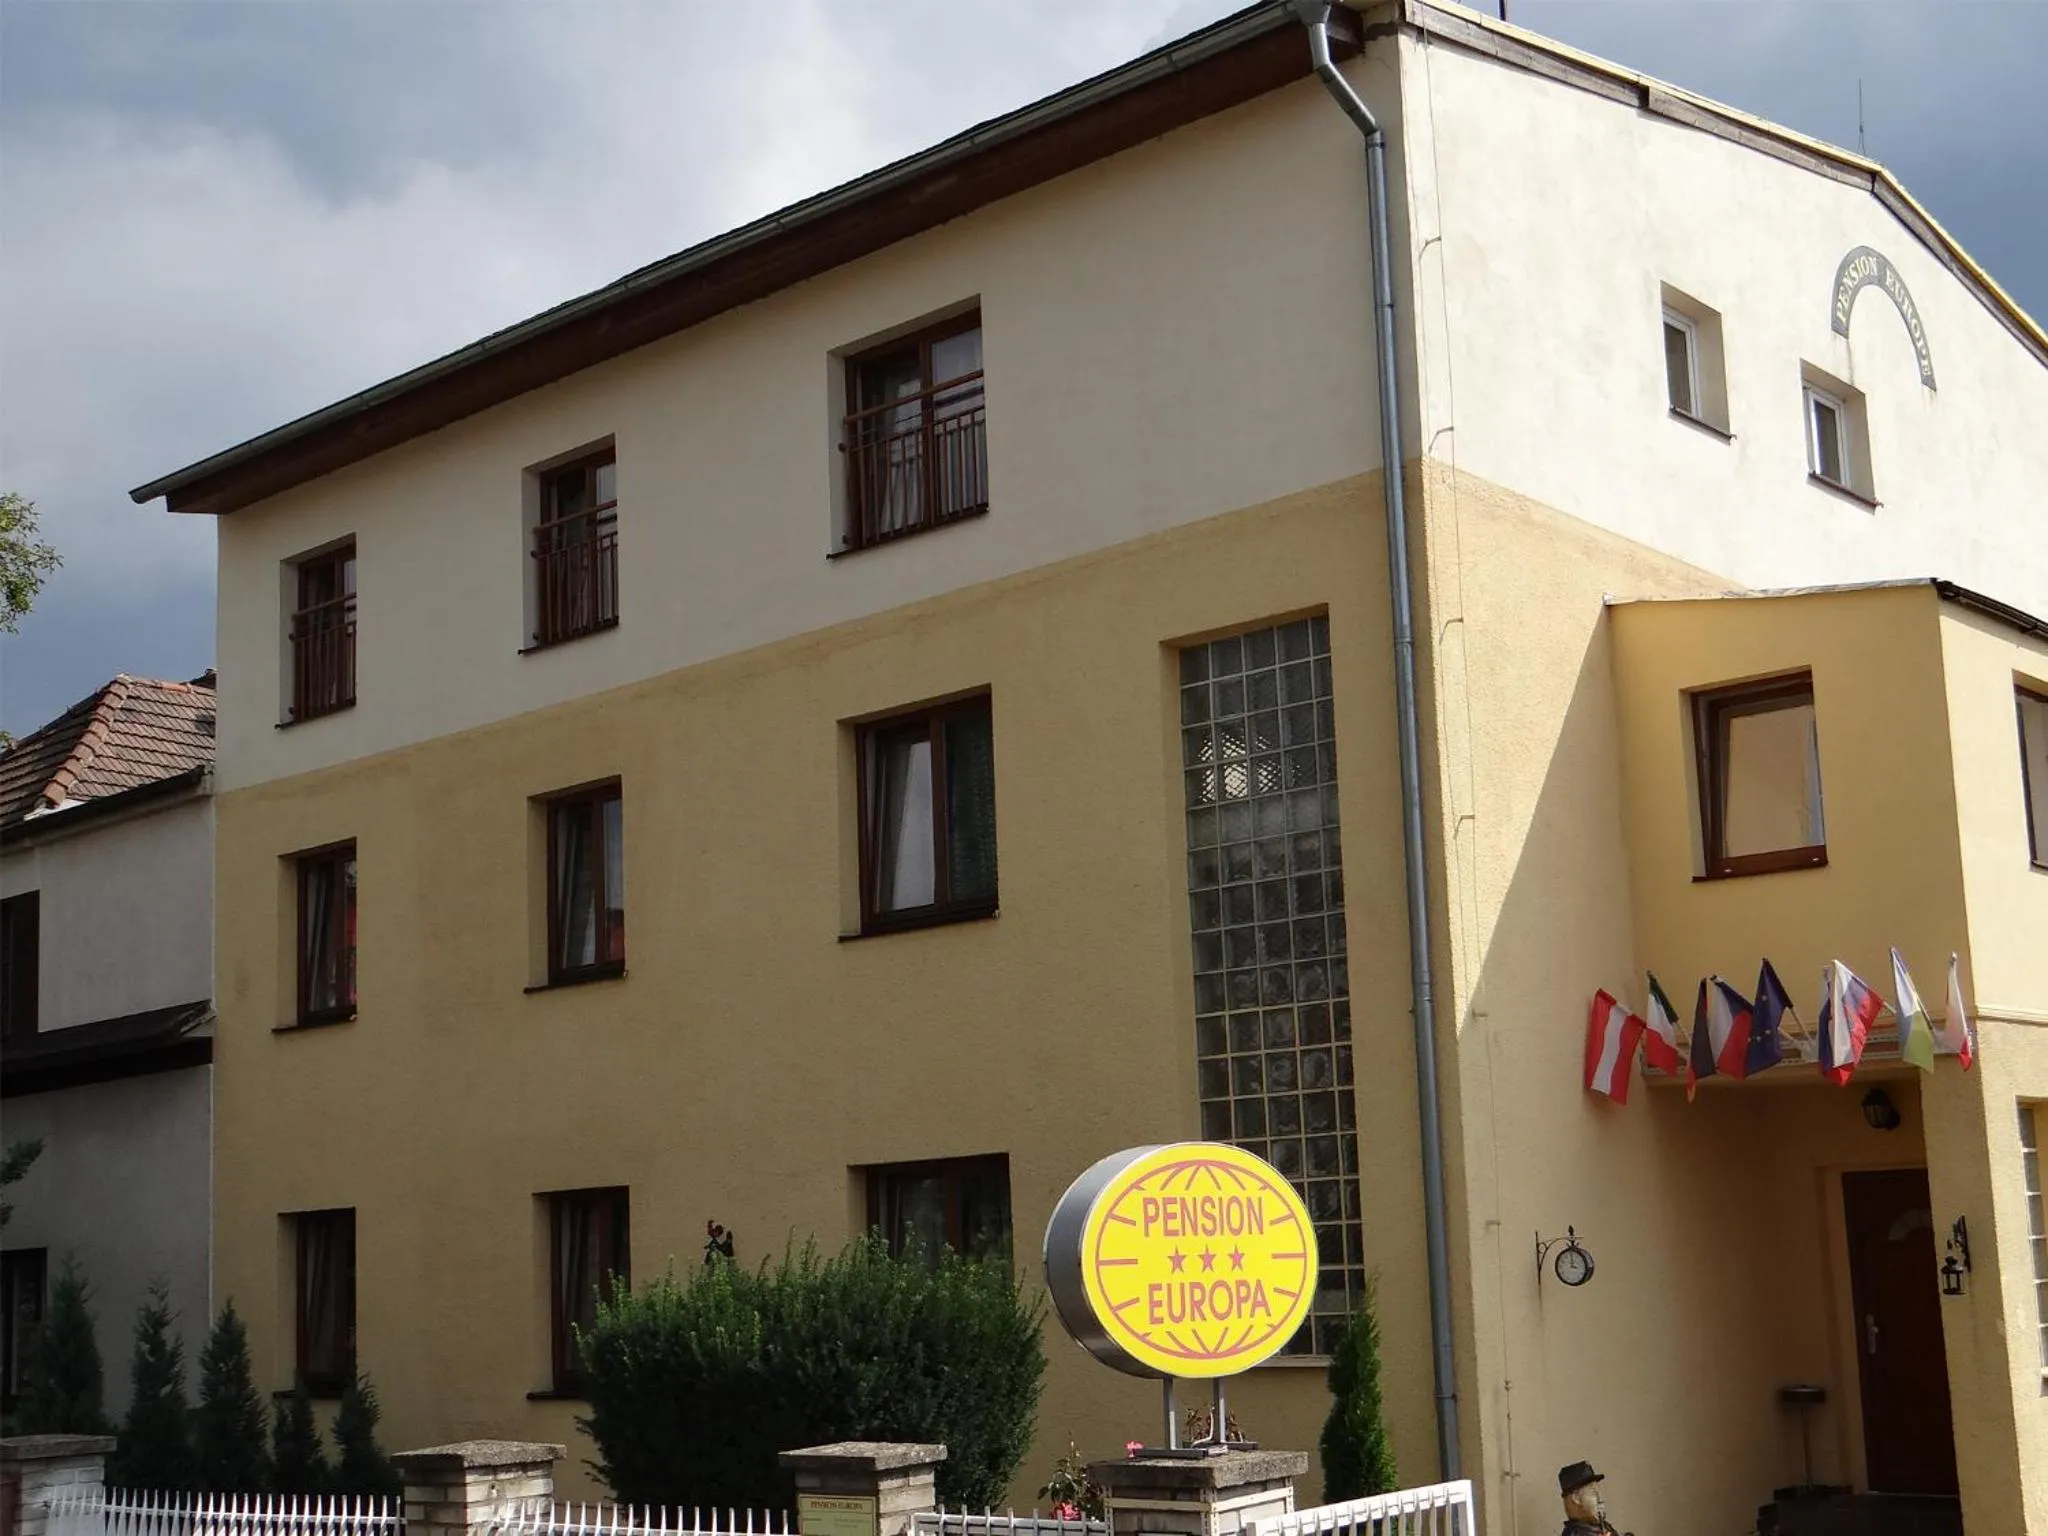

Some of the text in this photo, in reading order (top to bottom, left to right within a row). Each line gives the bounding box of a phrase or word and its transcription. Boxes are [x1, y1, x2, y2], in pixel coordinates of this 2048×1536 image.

[1836, 255, 1878, 326] PENSION
[1142, 1196, 1264, 1237] PENSION
[1147, 1279, 1272, 1325] EUROPA
